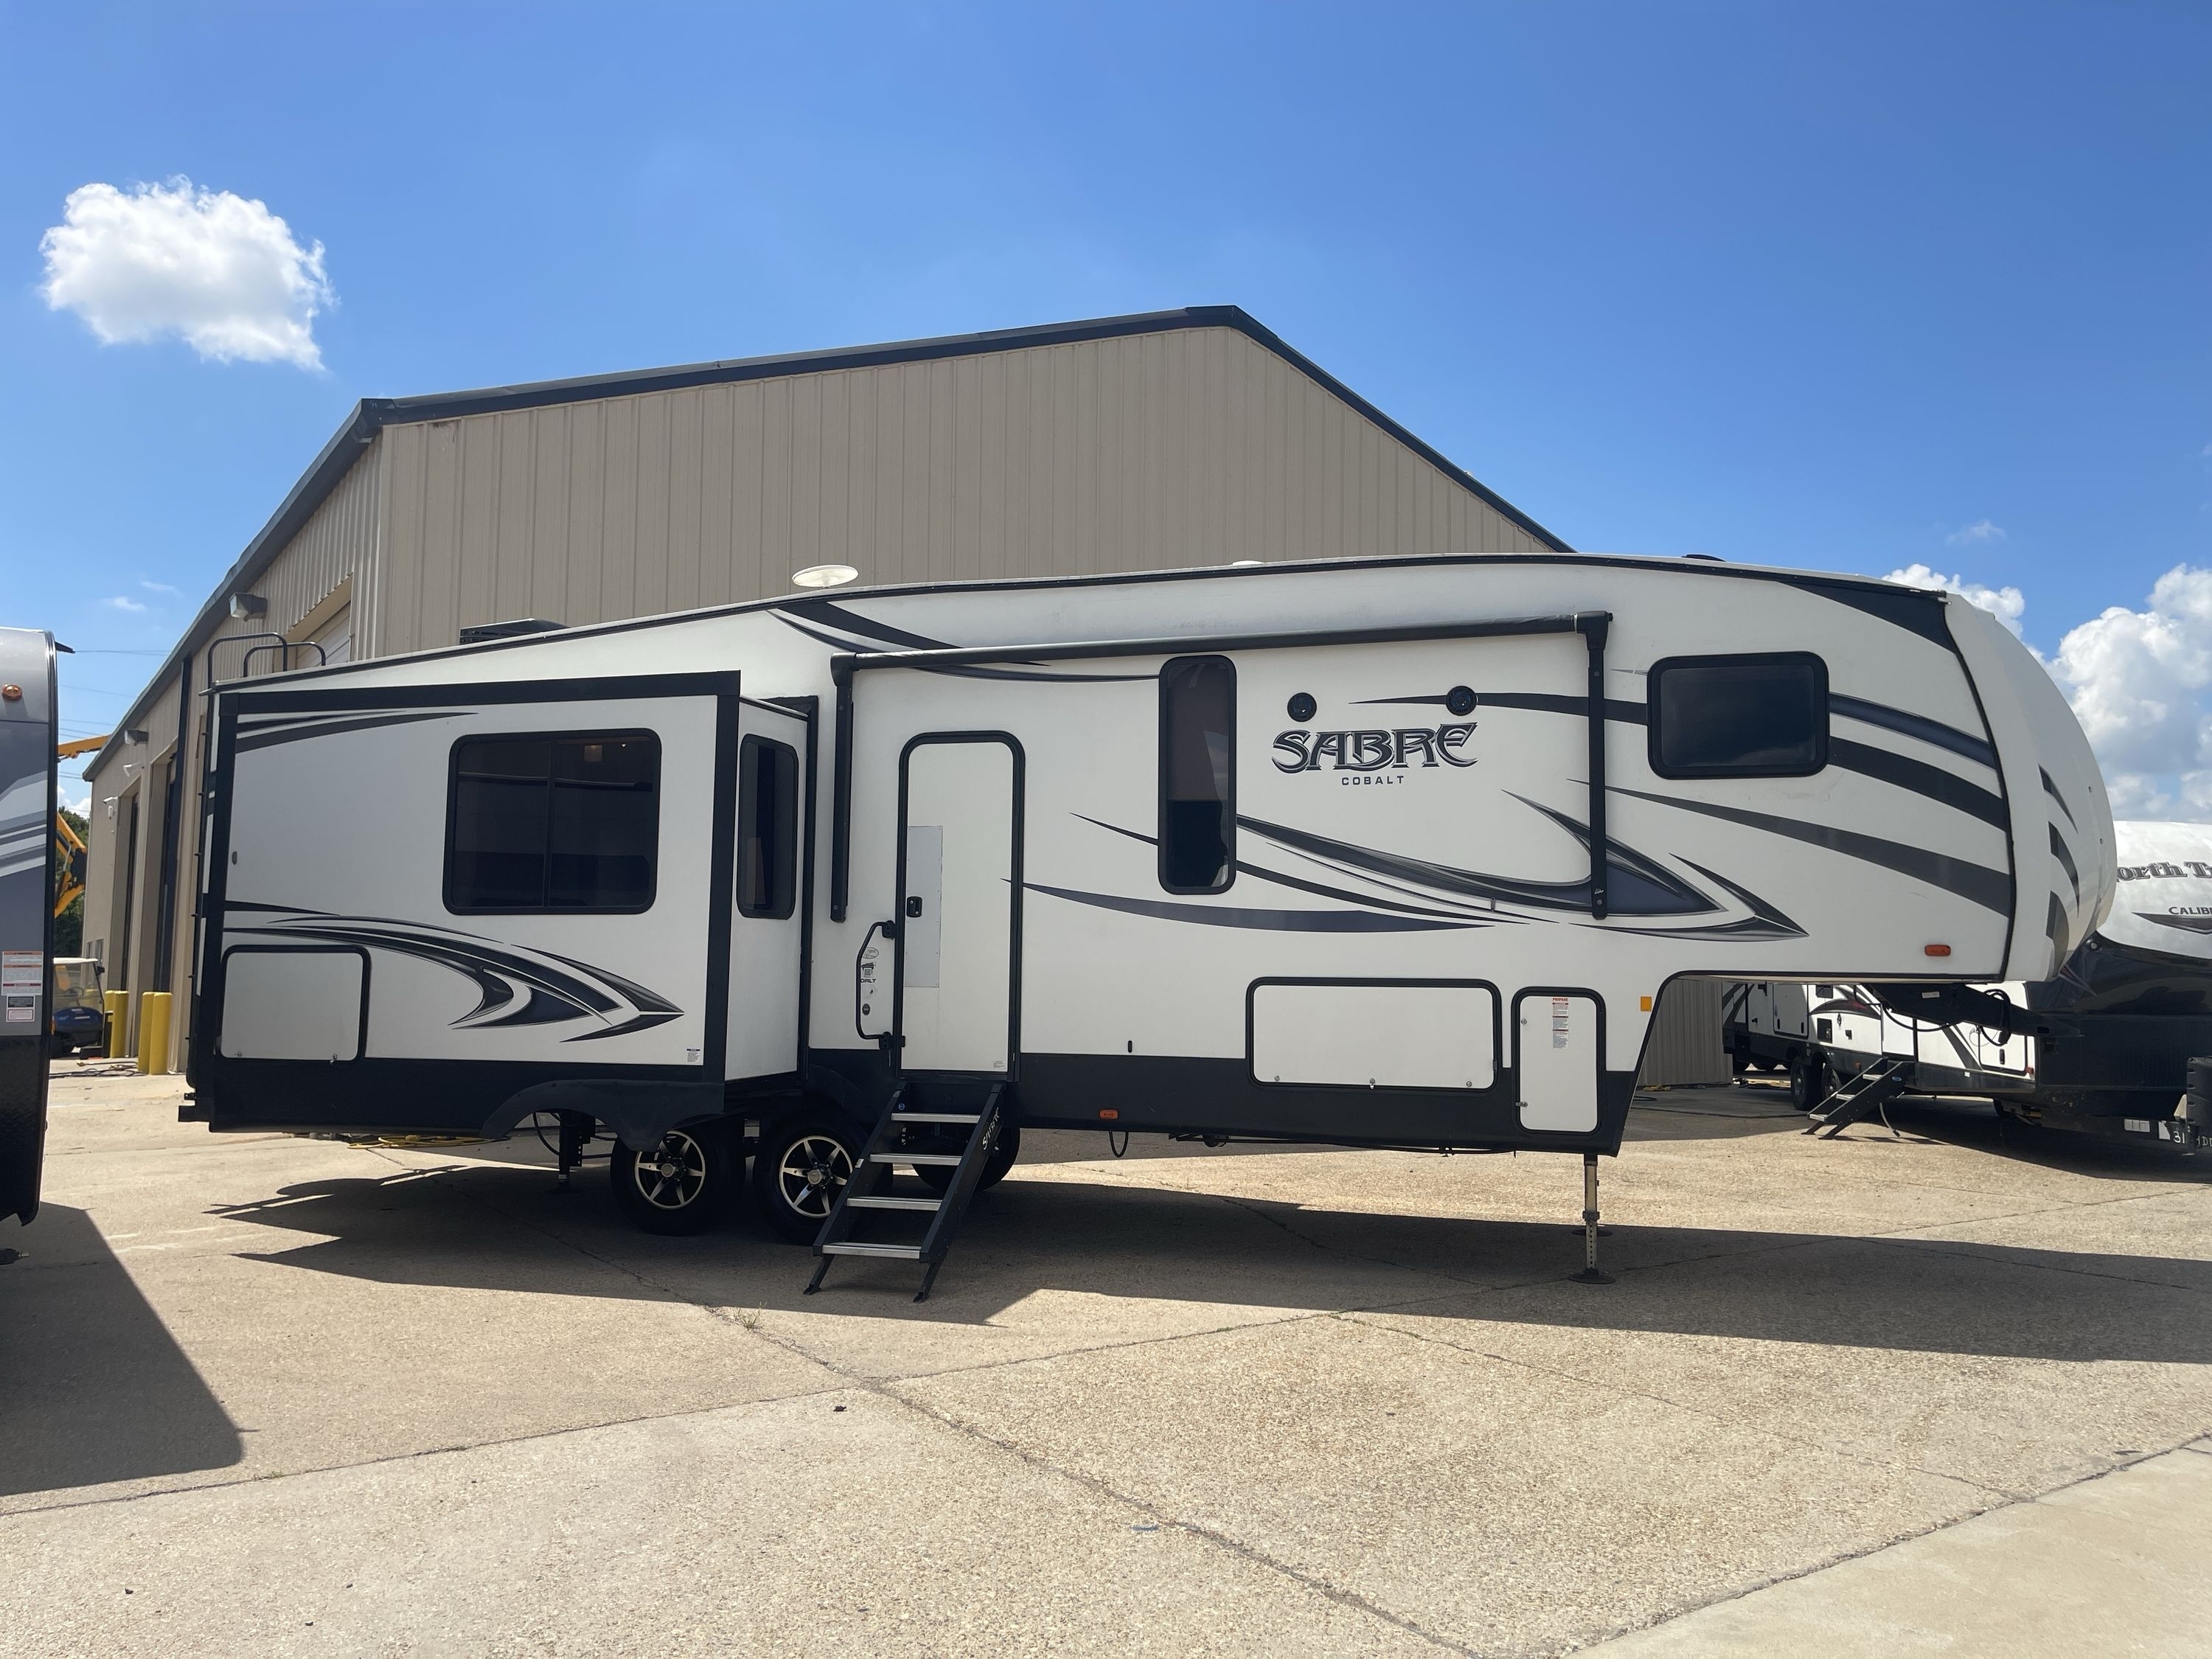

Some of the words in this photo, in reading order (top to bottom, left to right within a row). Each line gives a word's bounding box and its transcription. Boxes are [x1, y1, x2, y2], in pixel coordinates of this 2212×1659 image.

[1271, 722, 1478, 774] SABRE
[1341, 775, 1405, 786] COBALT
[2116, 861, 2188, 883] orth
